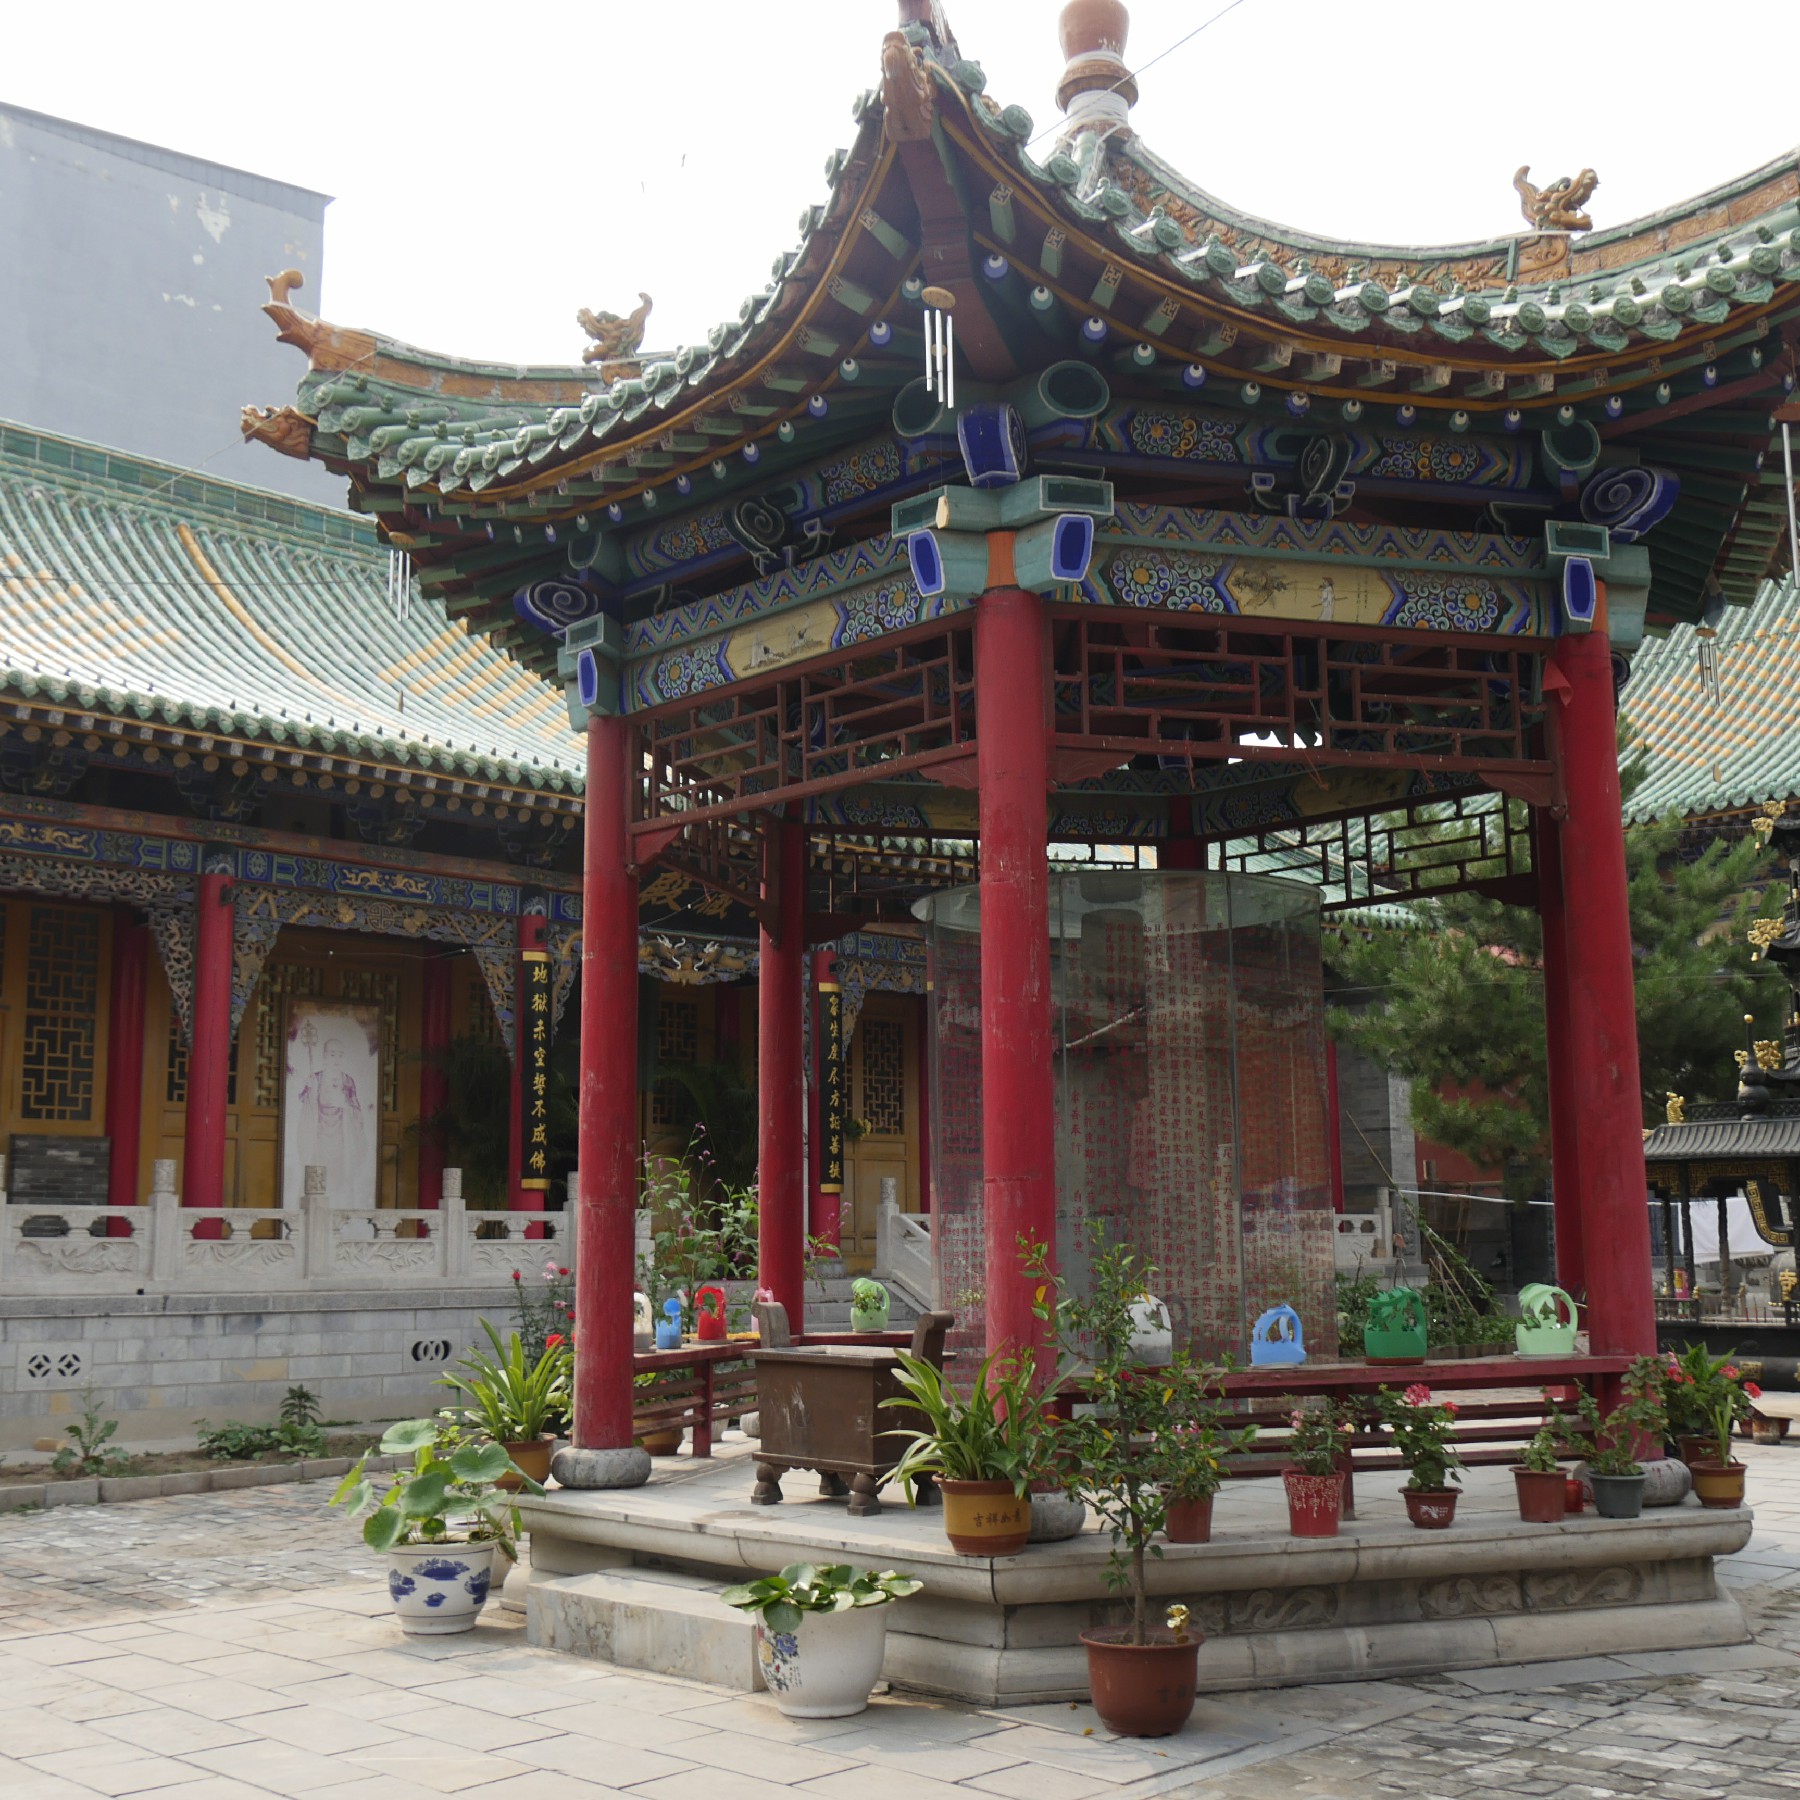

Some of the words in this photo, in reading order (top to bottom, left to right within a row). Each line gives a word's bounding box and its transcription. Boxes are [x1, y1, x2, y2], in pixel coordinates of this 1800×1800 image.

[529, 962, 548, 1175] 地獄未空誓不成佛
